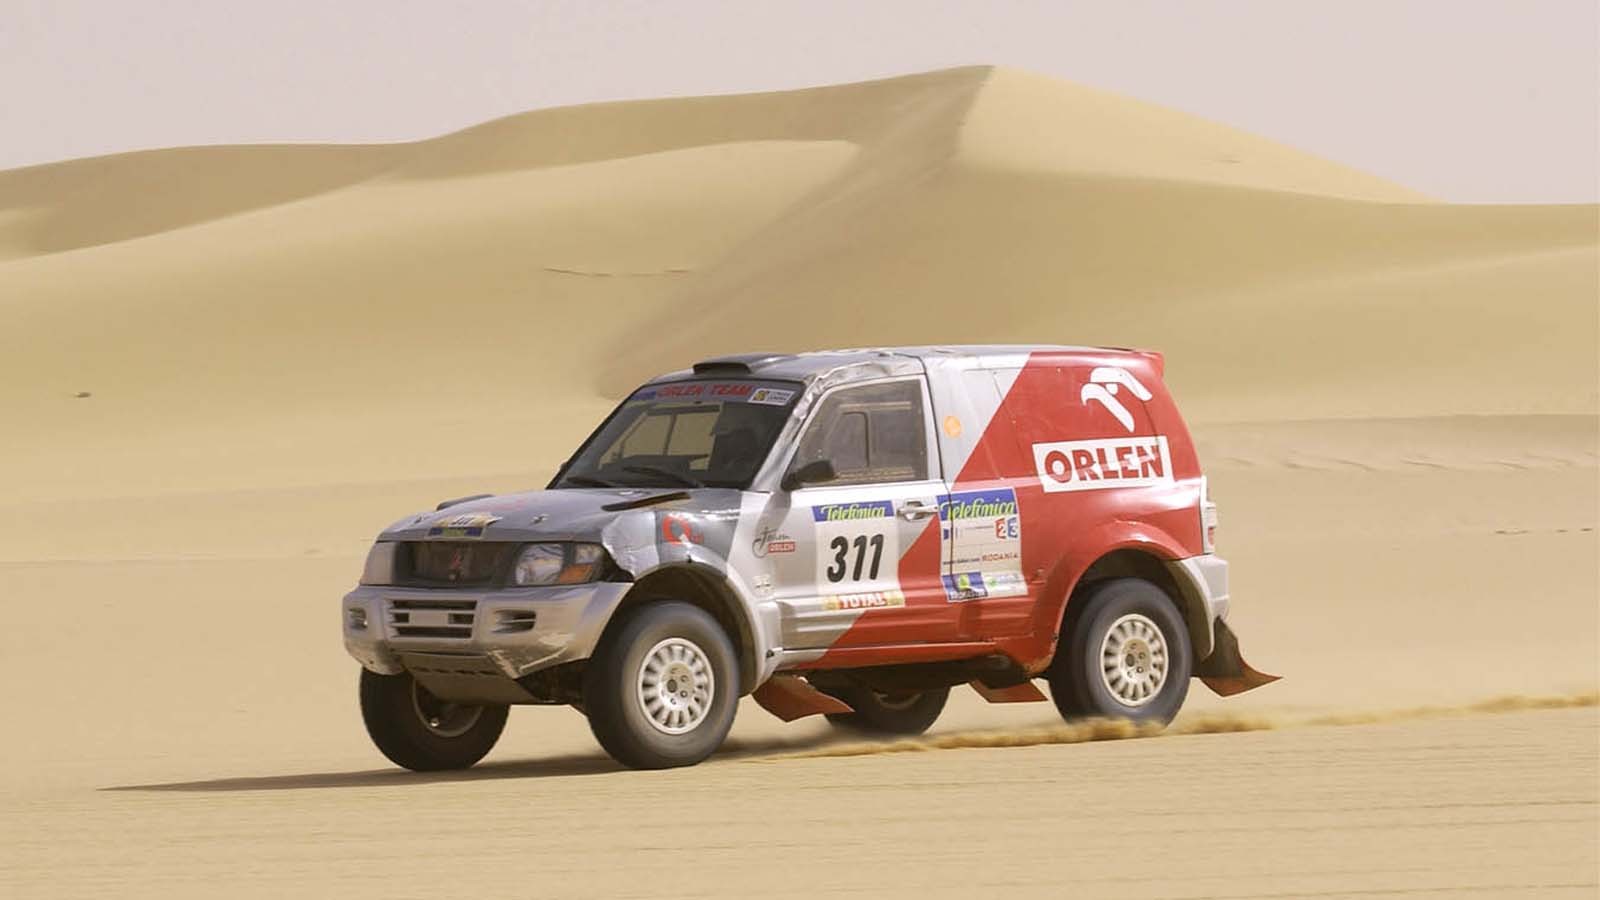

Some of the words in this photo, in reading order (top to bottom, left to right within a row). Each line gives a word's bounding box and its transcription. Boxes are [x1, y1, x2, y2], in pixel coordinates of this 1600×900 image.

[711, 384, 754, 396] TEAM
[1045, 445, 1164, 483] ORLEN
[827, 534, 884, 583] 311
[838, 594, 888, 609] TOTAL
